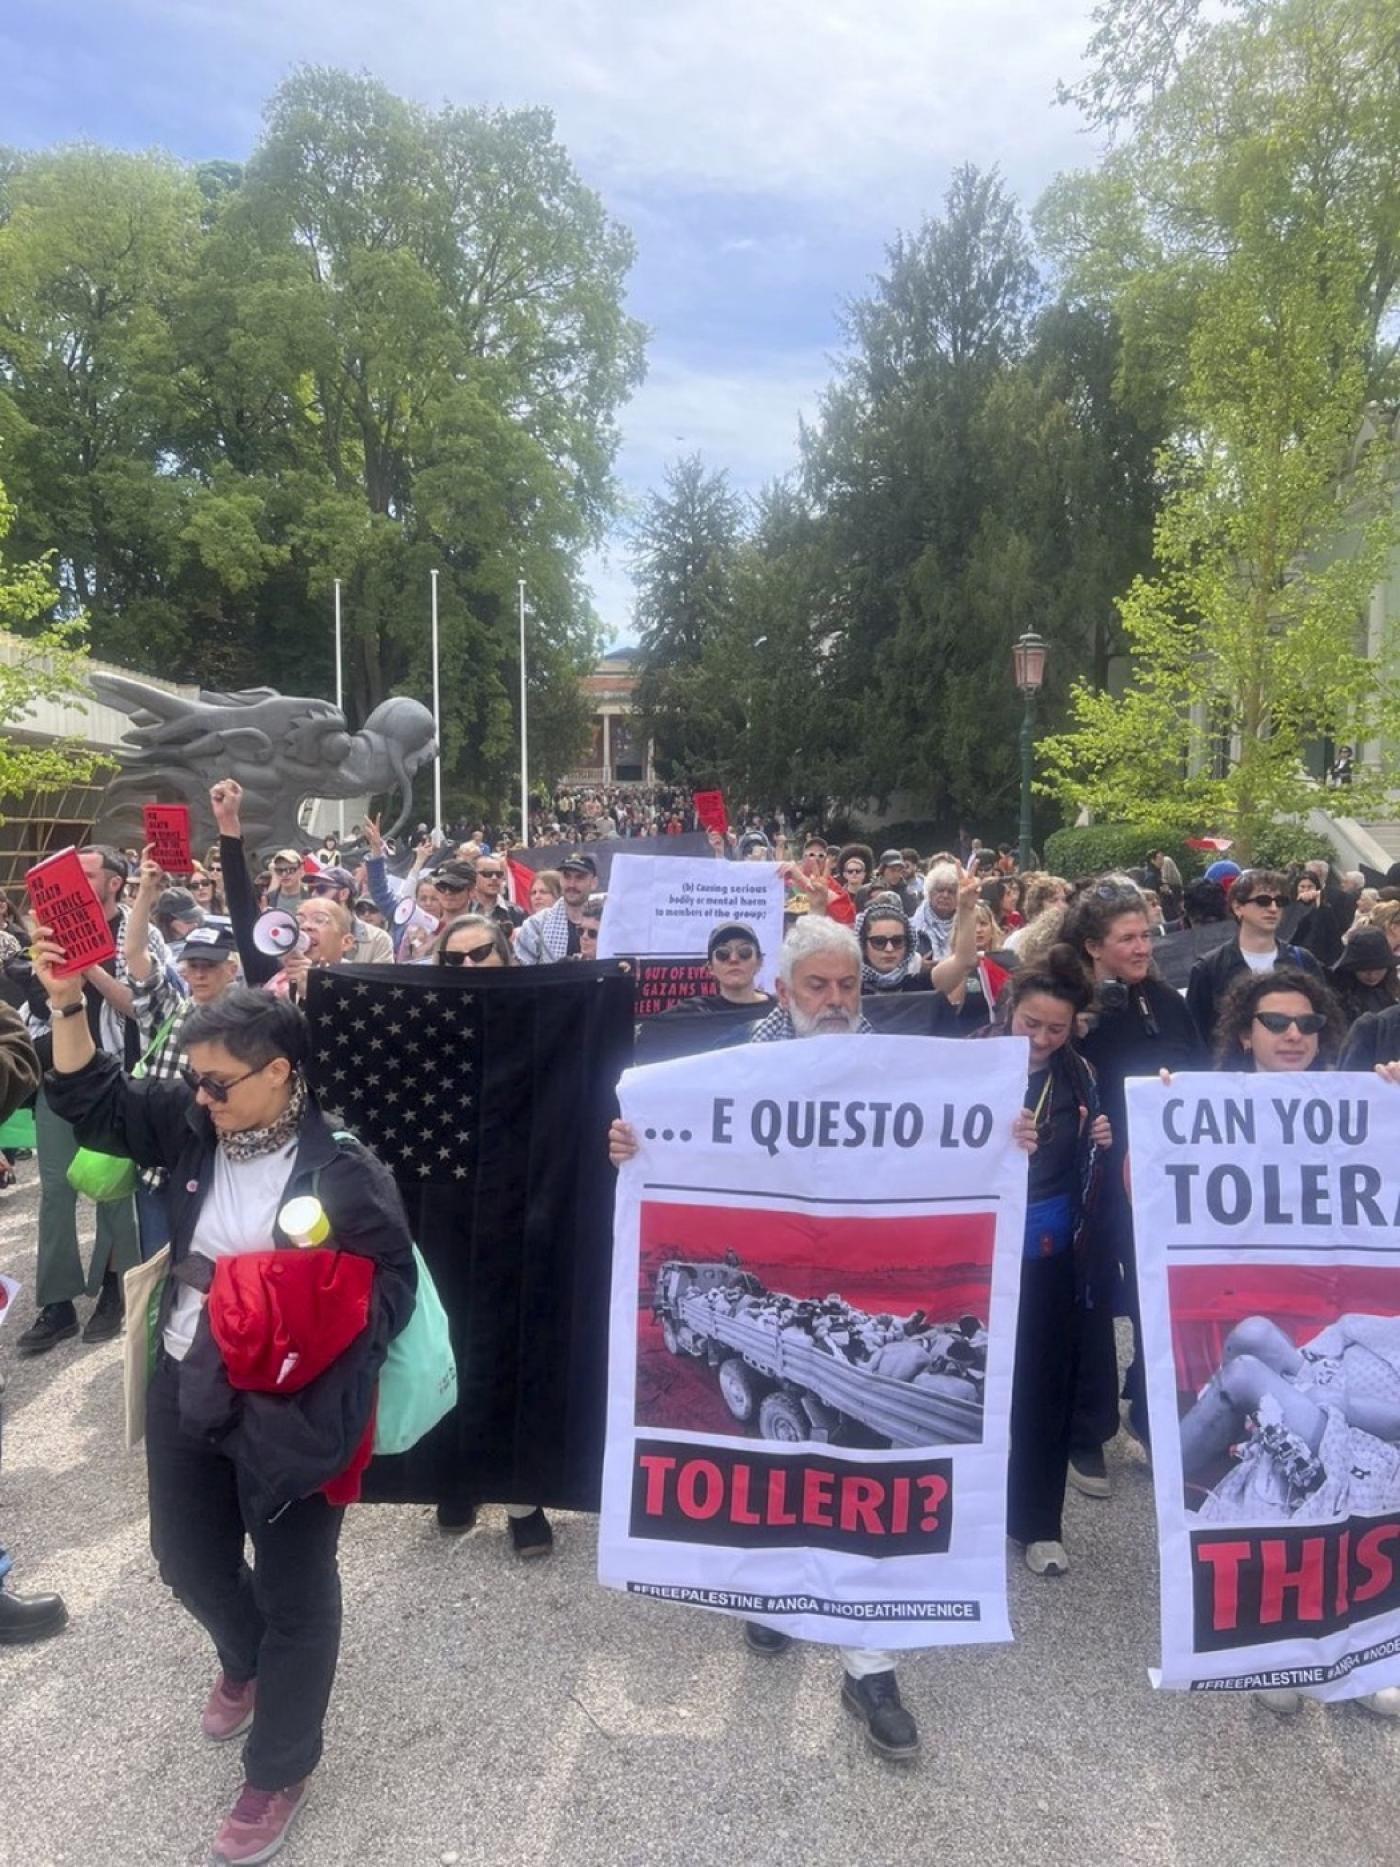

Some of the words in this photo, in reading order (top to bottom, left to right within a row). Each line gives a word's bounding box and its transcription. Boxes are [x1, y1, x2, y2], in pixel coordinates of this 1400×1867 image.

[35, 883, 62, 906] DEATH
[682, 881, 695, 893] (b)
[730, 884, 767, 893] serious
[51, 891, 84, 913] VENICE
[669, 893, 694, 906] bodily
[706, 896, 738, 905] mental
[740, 896, 767, 906] harm
[58, 914, 72, 931] TO
[71, 907, 90, 923] THE
[655, 908, 664, 916] to
[665, 907, 702, 917] members
[704, 908, 713, 917] of
[714, 908, 730, 917] the
[64, 932, 107, 960] AVILION
[670, 966, 686, 980] OF
[642, 982, 696, 997] GAZANS
[712, 1097, 735, 1144] E
[751, 1098, 925, 1157] QUESTO
[940, 1103, 994, 1149] LO
[1162, 1098, 1256, 1145] CAN
[1271, 1098, 1369, 1146] YOU
[1165, 1163, 1400, 1227] TOLER
[639, 1455, 949, 1535] TOLLERI?
[1197, 1524, 1400, 1631] THIS
[633, 1584, 763, 1610] #FREEPALESTINE
[767, 1596, 819, 1612] #ANGA
[822, 1600, 974, 1617] #NODEATHINVENICE
[1197, 1668, 1323, 1690] #FREEPALESTINE
